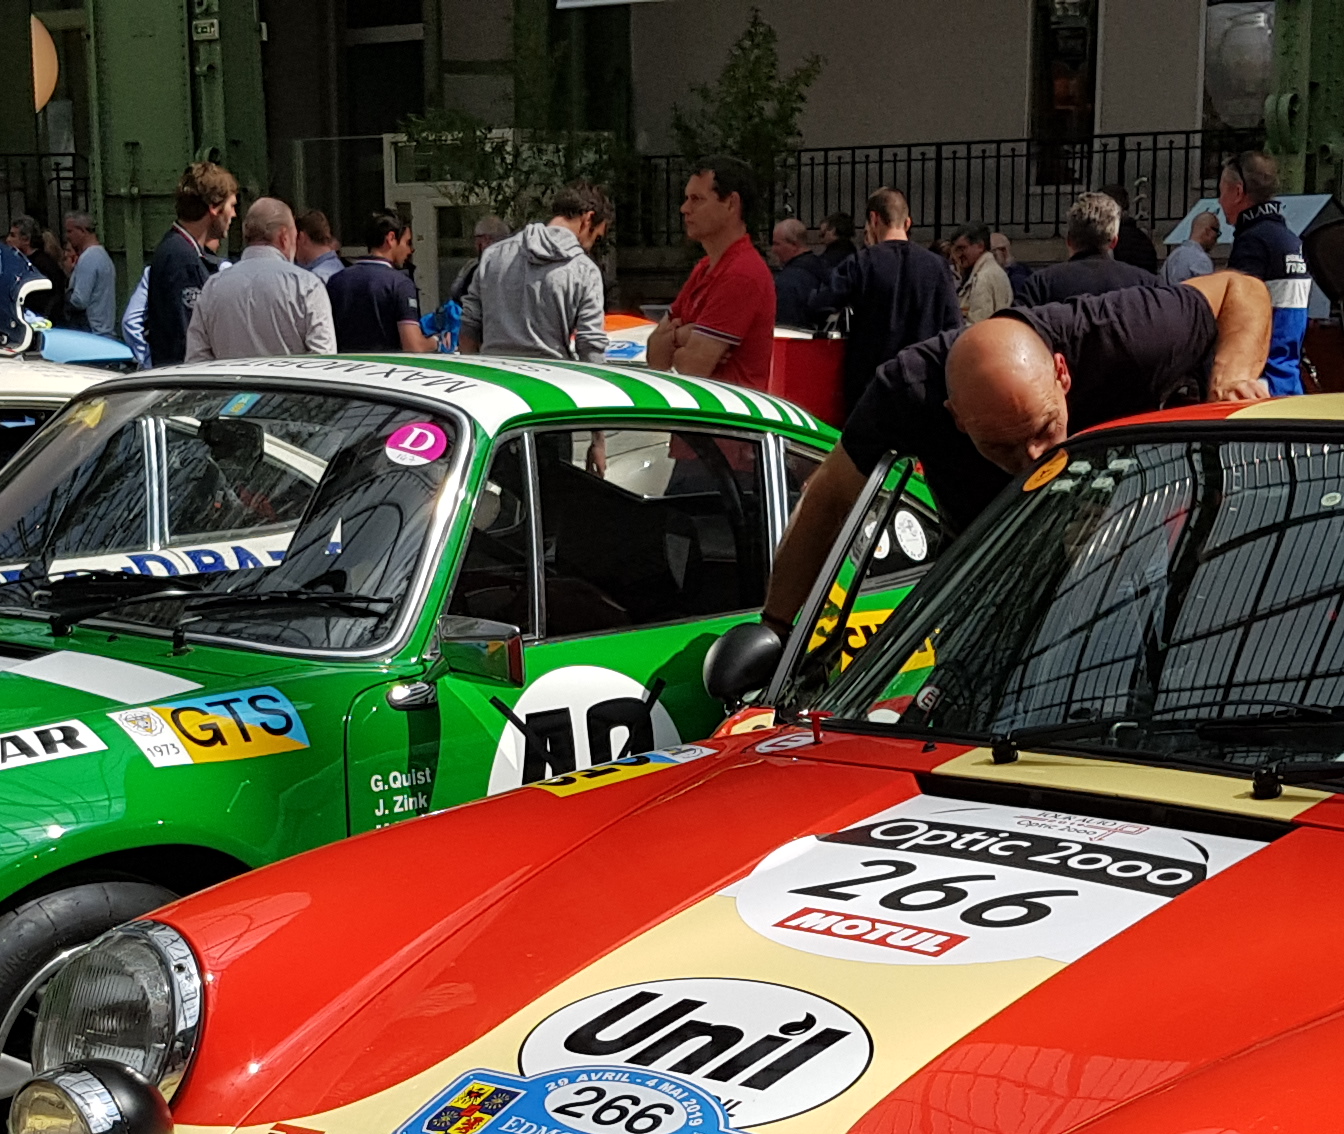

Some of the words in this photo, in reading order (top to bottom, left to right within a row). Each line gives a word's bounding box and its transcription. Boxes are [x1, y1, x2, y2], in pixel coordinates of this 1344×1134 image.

[400, 427, 436, 452] D
[170, 693, 294, 748] GTS
[147, 743, 180, 757] 1973
[393, 792, 428, 814] Zink
[869, 820, 1027, 857] Optic
[1028, 842, 1194, 886] 2000
[788, 859, 1081, 928] 266
[796, 912, 952, 953] MOTUL
[563, 991, 852, 1093] Unil
[551, 1085, 675, 1134] 266
[576, 1071, 631, 1085] AVRIL
[645, 1077, 656, 1087] 4
[661, 1082, 689, 1104] MAI
[684, 1097, 703, 1128] 2019
